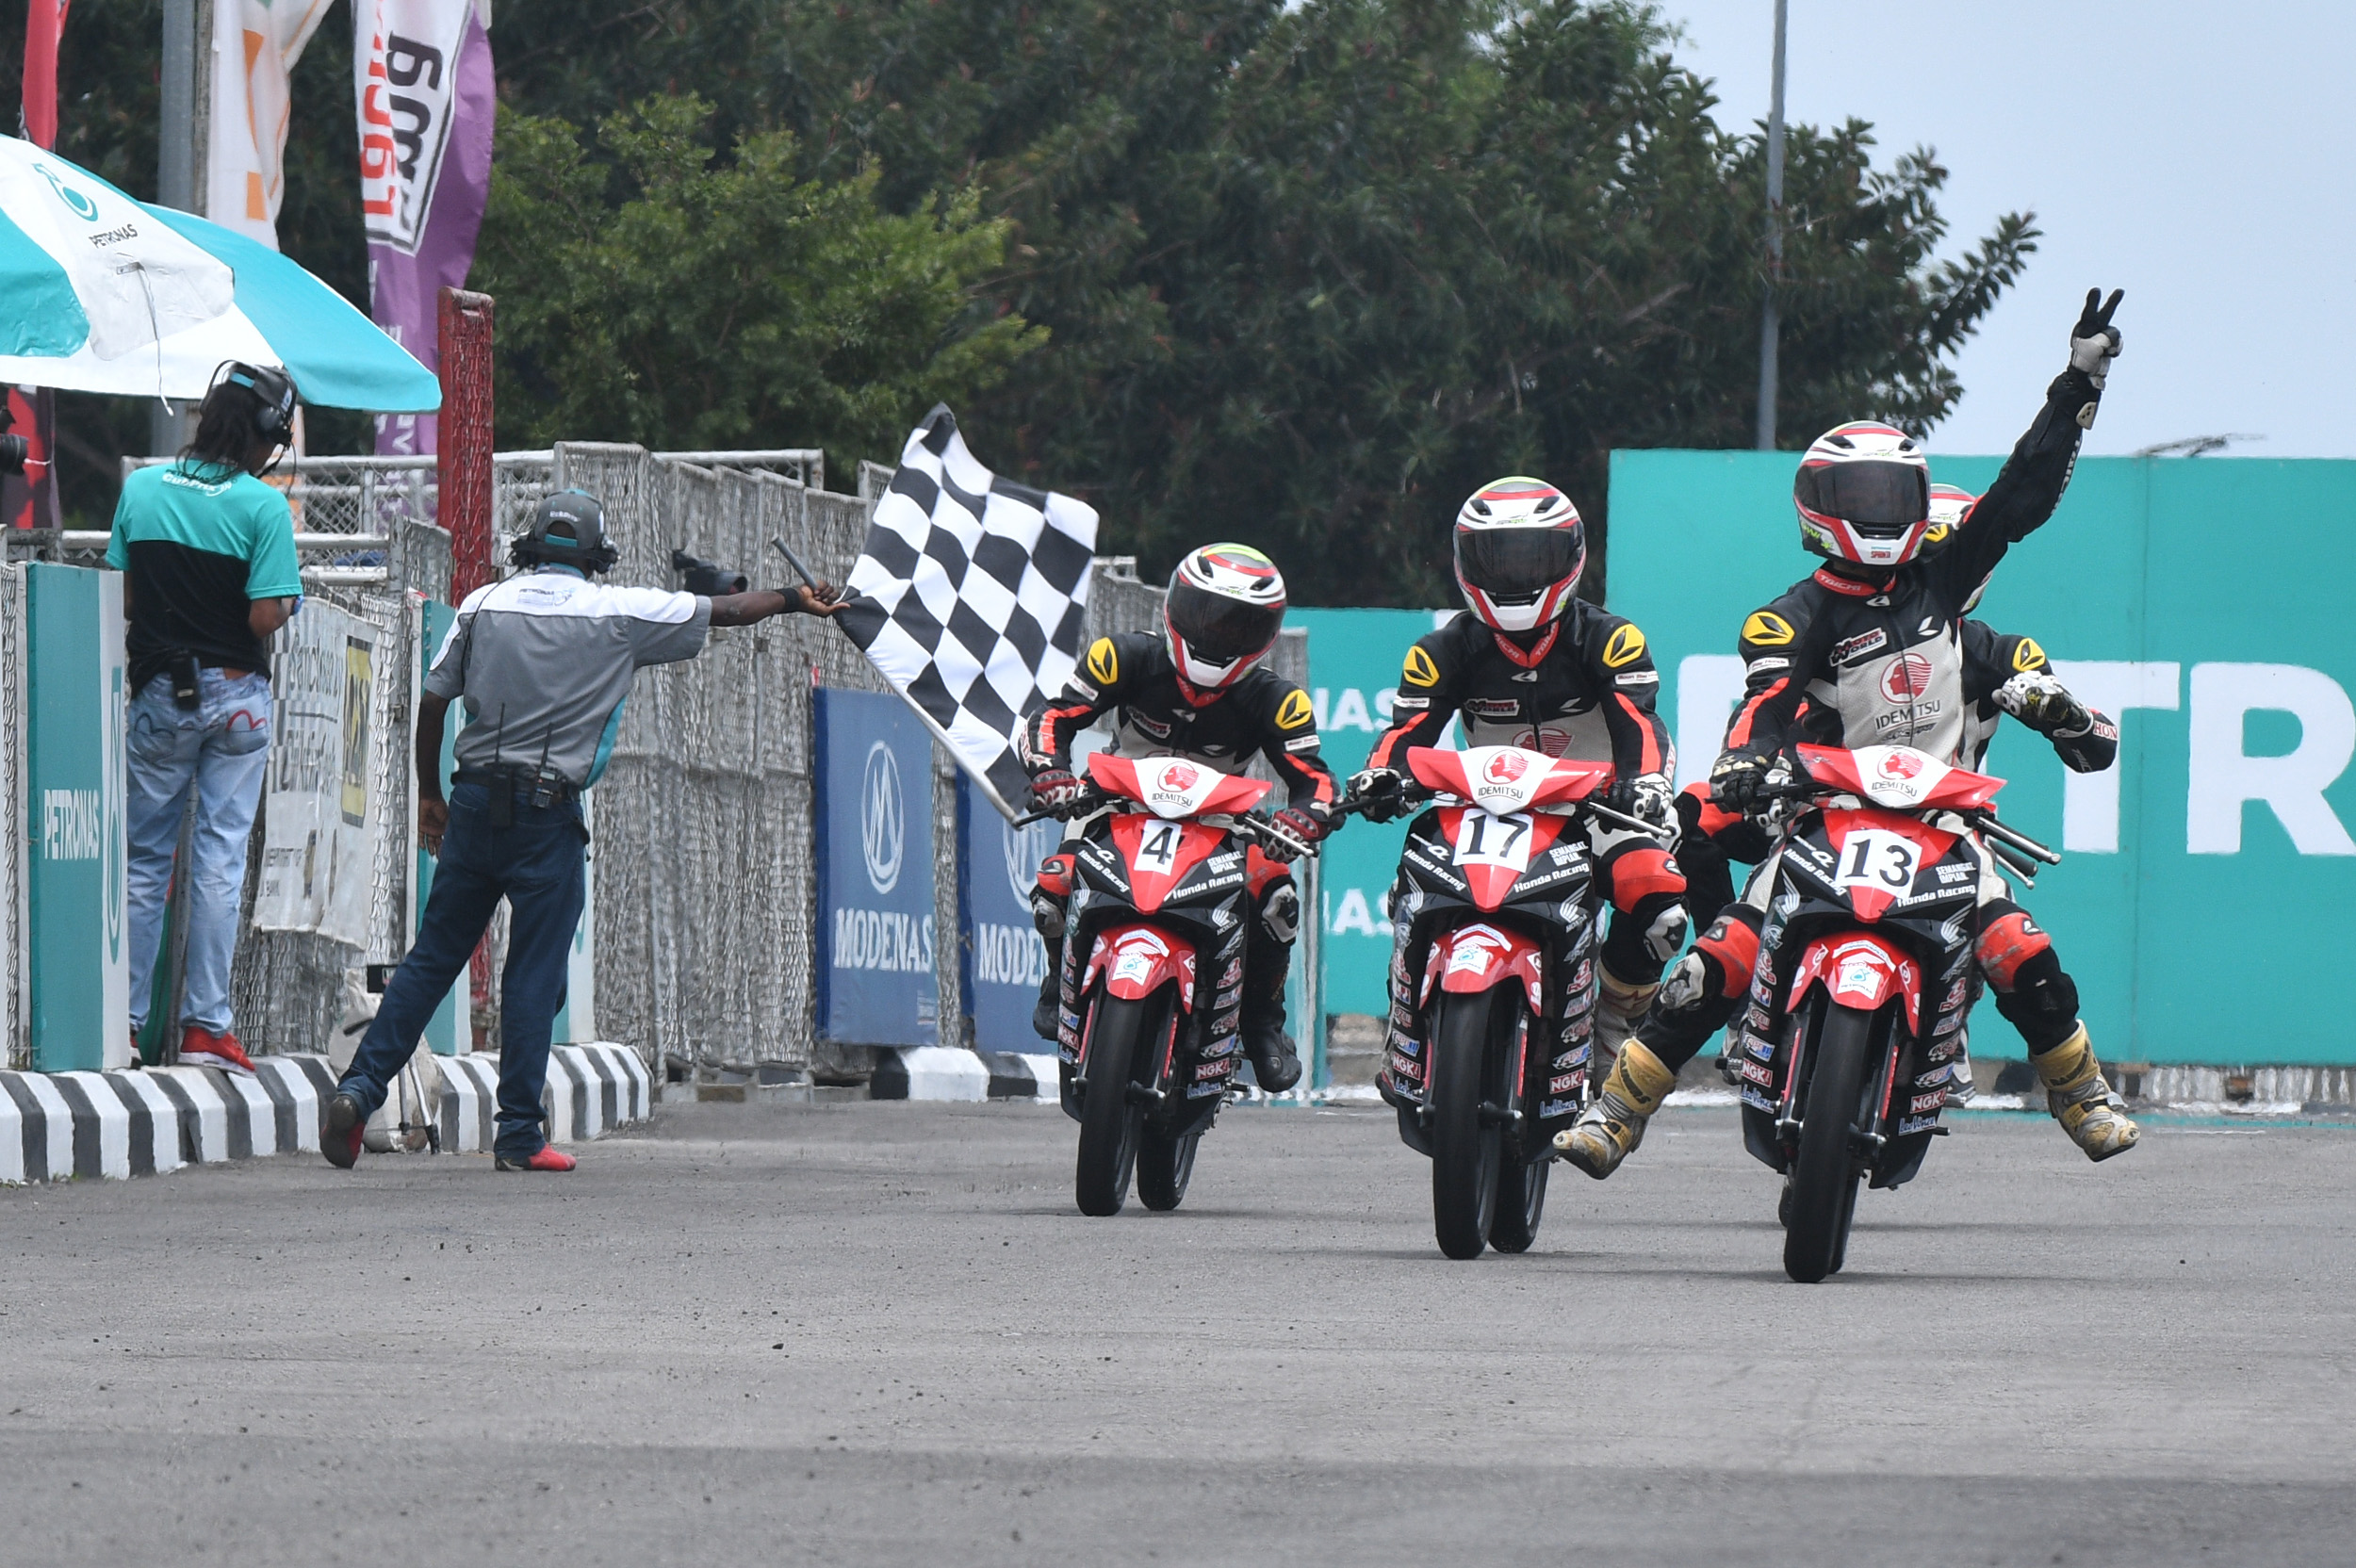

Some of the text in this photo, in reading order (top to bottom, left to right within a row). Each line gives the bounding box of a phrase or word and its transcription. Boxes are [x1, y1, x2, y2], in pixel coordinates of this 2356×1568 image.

[88, 222, 139, 249] PETRONAS
[1874, 699, 1941, 730] IDEMTSU
[1152, 792, 1193, 808] IDEMITSU
[1478, 786, 1524, 799] IDEMITSU
[1872, 781, 1918, 797] IDEMITSU
[44, 788, 100, 860] PETRONAS
[1462, 814, 1530, 858] 17
[1142, 826, 1172, 866] 4
[1783, 848, 1817, 873] Honda
[1078, 849, 1130, 893] Honda Racing
[1403, 848, 1466, 892] Honda Racing
[1513, 862, 1590, 893] Honda Racing
[1844, 839, 1912, 887] 13
[1172, 872, 1244, 901] Honda Racing
[1937, 884, 1976, 899] Racing
[833, 906, 933, 973] MODENAS
